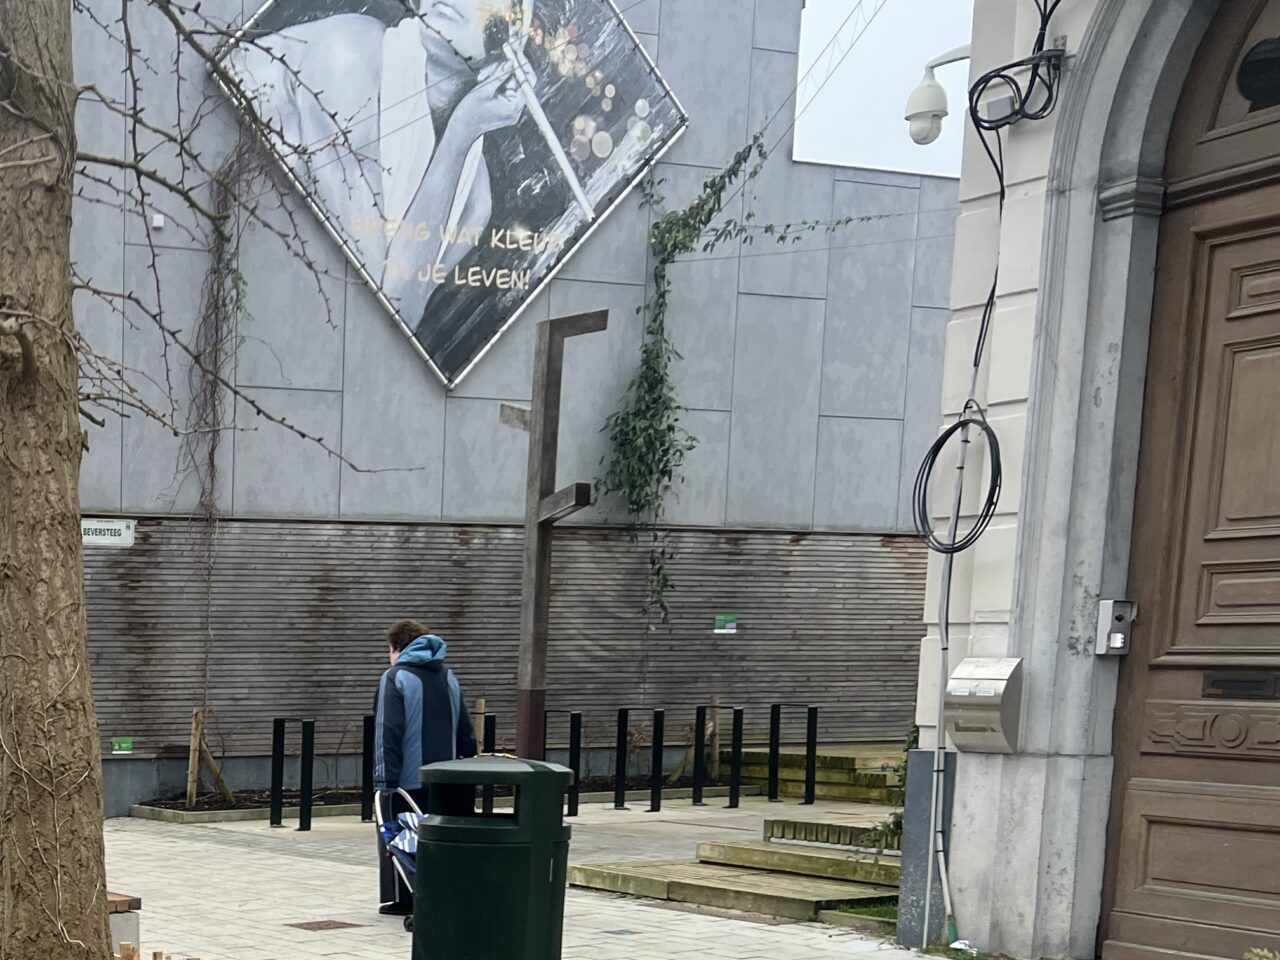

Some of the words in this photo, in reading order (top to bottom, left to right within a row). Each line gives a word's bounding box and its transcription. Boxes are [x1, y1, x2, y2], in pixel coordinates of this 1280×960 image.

[351, 216, 431, 241] BRENG
[439, 224, 484, 247] WAT
[490, 228, 561, 251] KLEUR
[384, 257, 410, 281] IN
[418, 264, 447, 284] JE
[454, 265, 532, 290] LEVEN!
[82, 527, 122, 537] BEVERSTEEG
